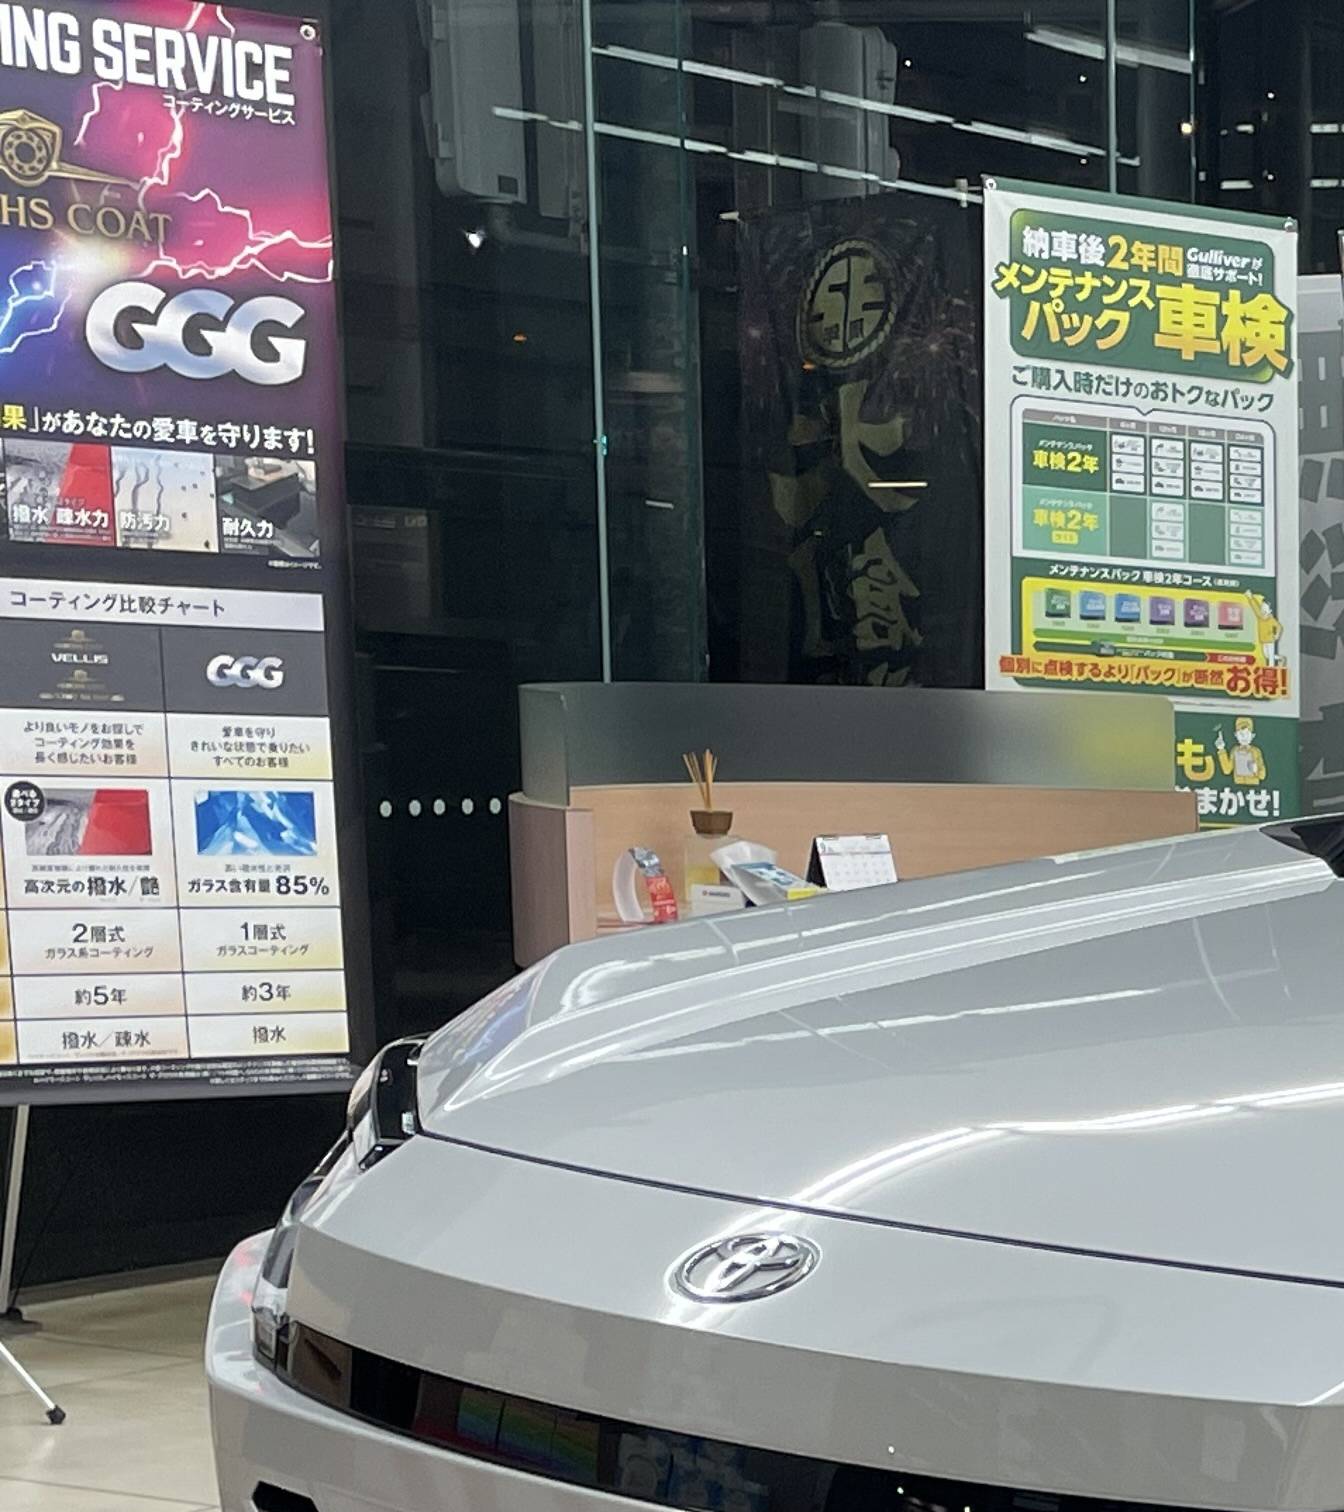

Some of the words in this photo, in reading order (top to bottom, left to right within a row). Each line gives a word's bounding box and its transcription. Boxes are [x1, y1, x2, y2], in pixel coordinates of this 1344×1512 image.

[92, 18, 296, 106] SERVICE
[164, 95, 296, 125] コーティングサービス
[67, 202, 173, 245] COAT
[1021, 225, 1184, 277] 納車後2年間
[994, 262, 1156, 311] メンテナンス
[85, 280, 307, 387] GGG
[1020, 298, 1132, 351] パック
[1153, 282, 1290, 372] 車検
[1012, 364, 1275, 413] ご購入時だけのおトクなパック
[1032, 449, 1100, 474] 車検2年
[222, 516, 274, 540] 耐久力
[1032, 507, 1099, 532] 車検2年
[1049, 564, 1141, 582] メンテナンスパック
[1142, 571, 1213, 588] 車検2年コース
[10, 589, 226, 617] コーティング比較チャート
[205, 654, 285, 690] GGG
[1174, 785, 1280, 818] まかせ!
[72, 922, 126, 944] 2層式
[240, 921, 287, 941] 1層式
[216, 944, 310, 958] ガラスコーティング
[74, 984, 128, 1006] 約5年
[241, 981, 292, 1002] 約3年
